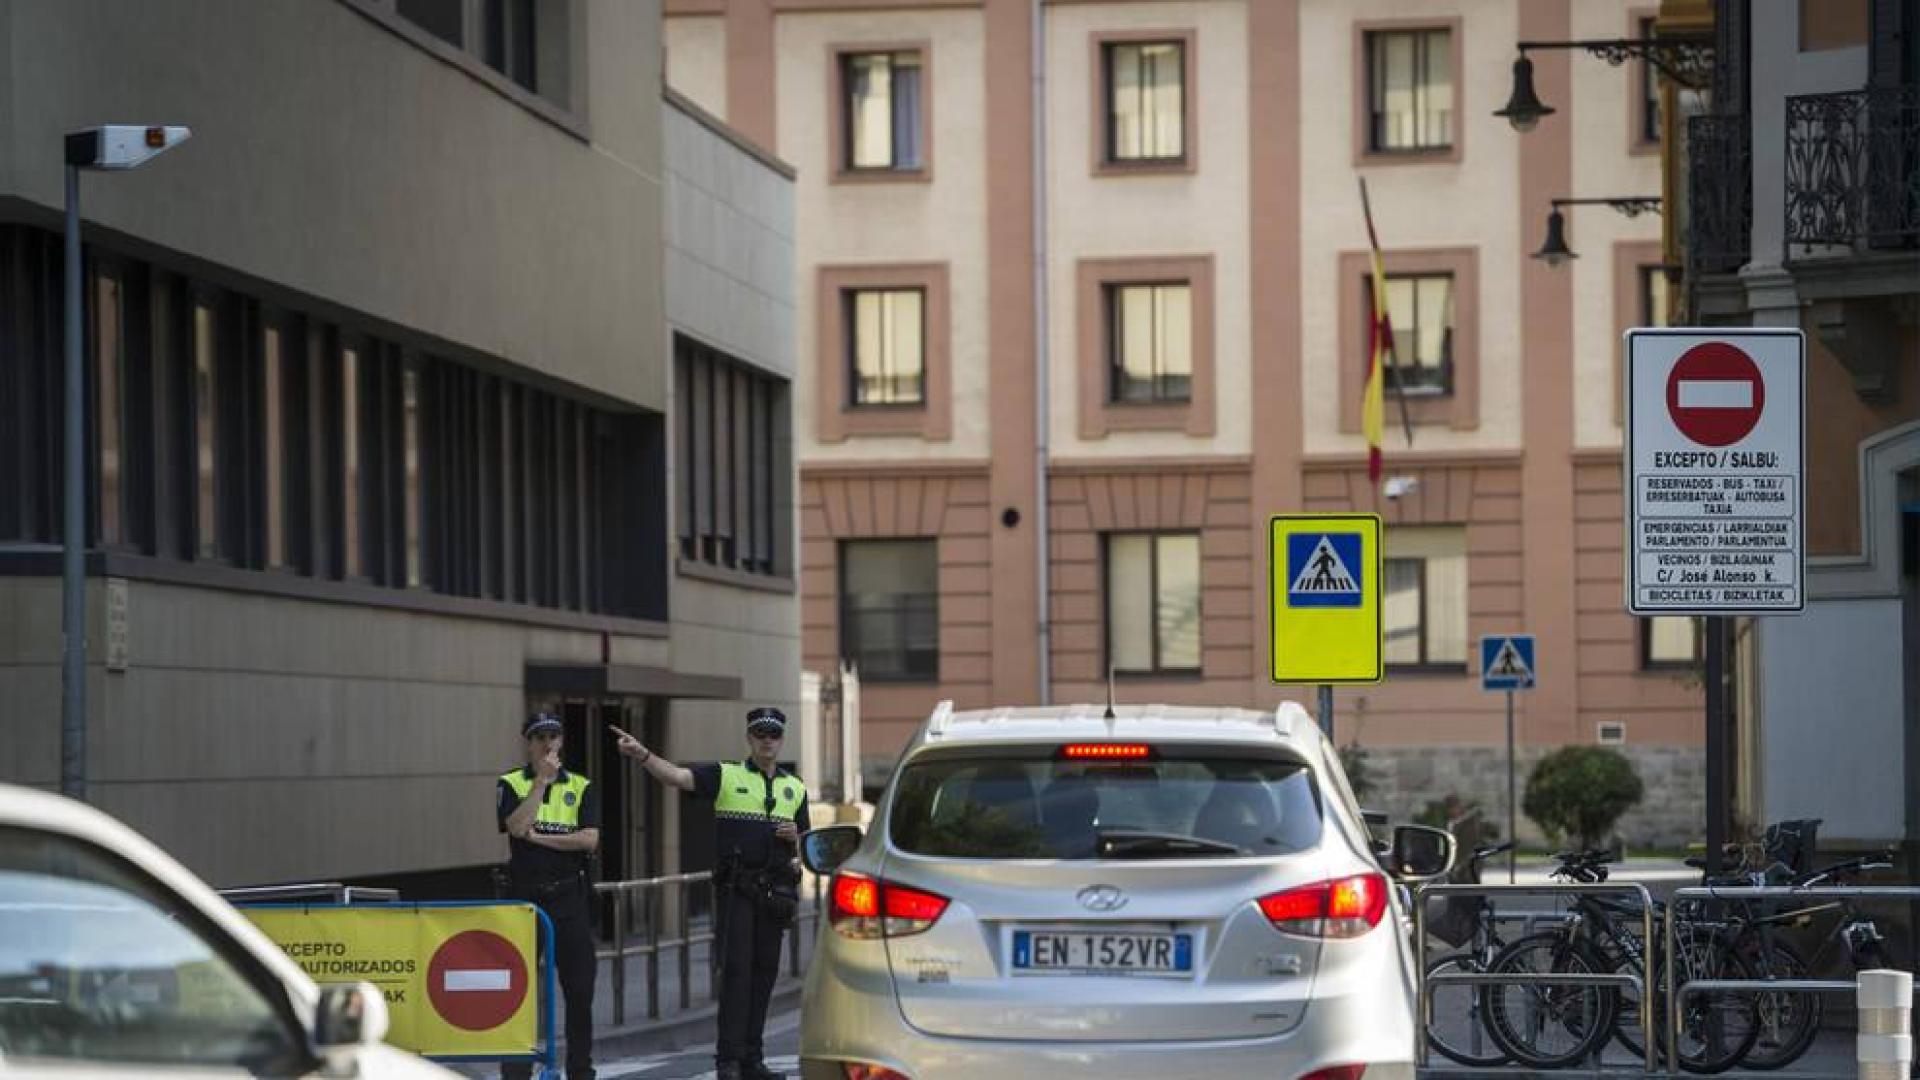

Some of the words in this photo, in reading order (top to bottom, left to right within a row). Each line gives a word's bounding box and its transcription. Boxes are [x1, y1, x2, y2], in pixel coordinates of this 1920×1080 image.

[1655, 452, 1717, 468] EXCEPTO
[1731, 452, 1779, 468] SALBU:
[1648, 478, 1714, 489] RESERVADOS
[1723, 478, 1744, 489] BUS
[1753, 478, 1776, 489] TAXI
[1646, 491, 1725, 502] ERRESERBATUAK
[1735, 491, 1785, 502] AUTOBUSA
[1703, 503, 1733, 515] TAXIA
[1644, 523, 1715, 533] EMERGENCIAS
[1723, 523, 1787, 533] LARRIALDIAK
[1646, 536, 1710, 546] PARLAMENTO
[1718, 536, 1787, 546] PARLAMENTUA
[1657, 554, 1701, 565] VECINOS
[1710, 554, 1775, 565] BIZILAGUNAK
[1657, 569, 1674, 583] C/
[1679, 568, 1708, 583] José
[1713, 568, 1756, 583] Alonso
[1649, 590, 1713, 600] BICICLETAS
[1723, 590, 1785, 600] BIZIKLETAK
[279, 943, 346, 957] XCEPTO
[1033, 936, 1069, 965] EN
[1085, 936, 1171, 967] 152VR
